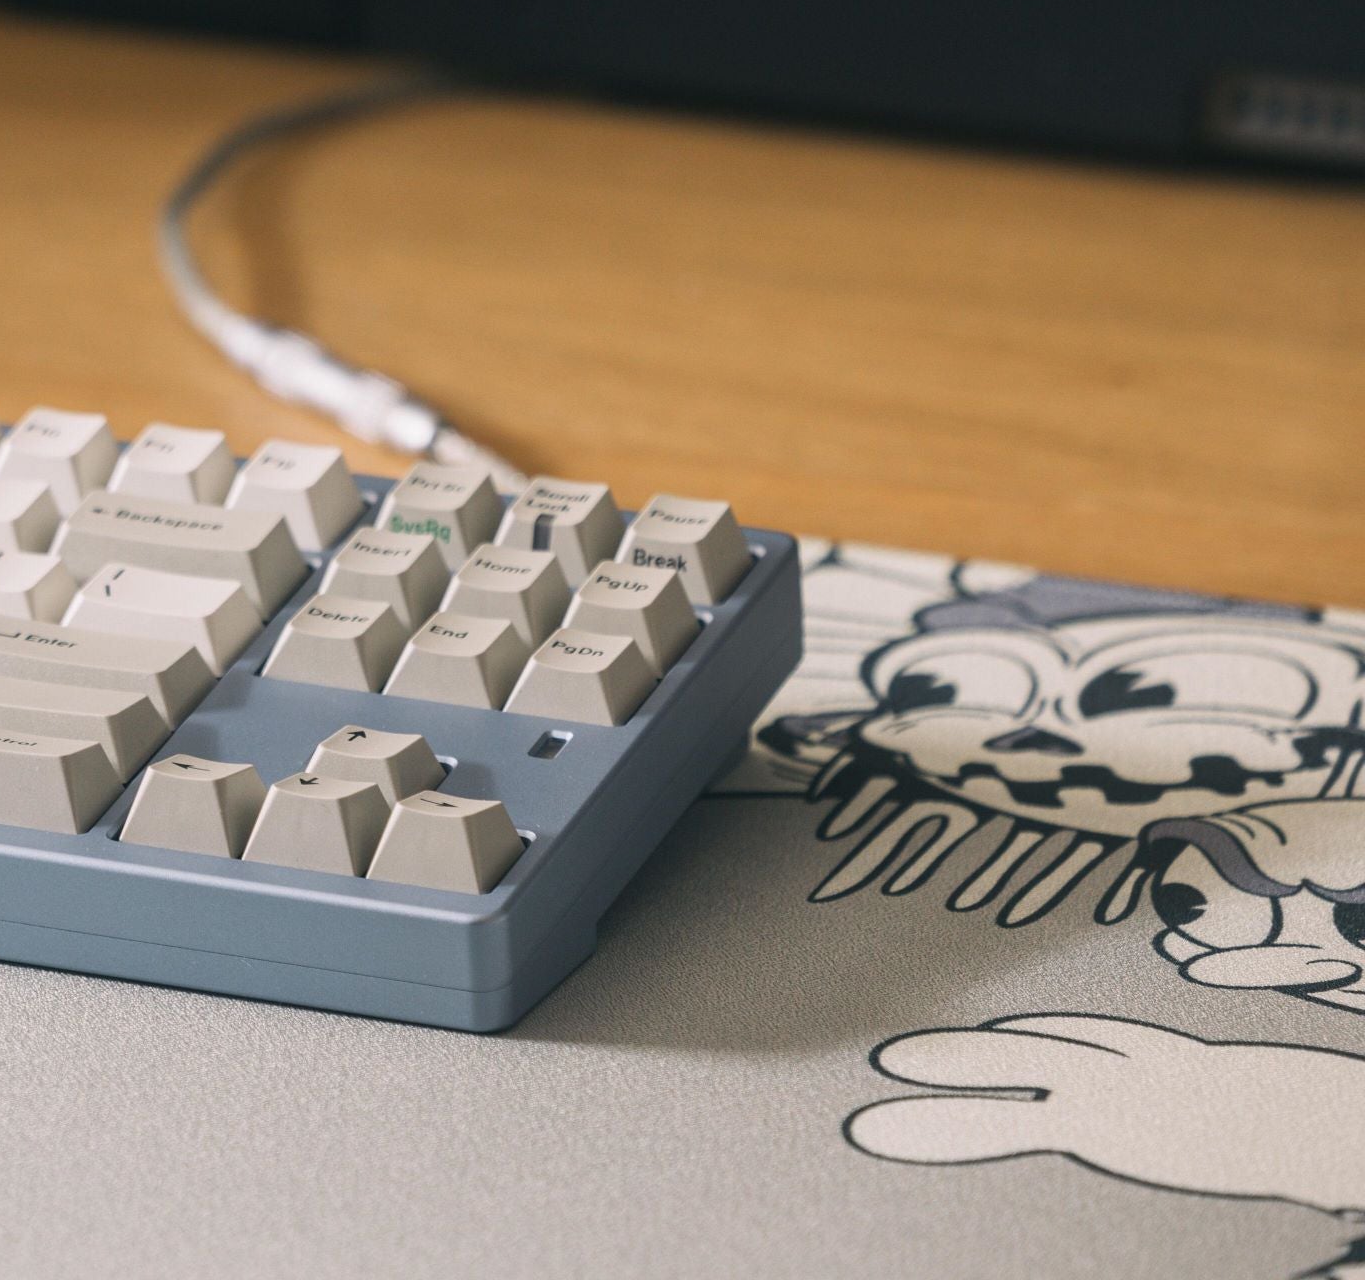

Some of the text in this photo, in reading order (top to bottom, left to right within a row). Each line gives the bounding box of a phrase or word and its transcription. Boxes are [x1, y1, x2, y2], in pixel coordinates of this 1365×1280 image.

[535, 487, 590, 503] Scroll
[526, 499, 571, 513] Lock
[115, 509, 224, 532] Backspace
[649, 508, 711, 525] Pause
[353, 541, 412, 557] Insert
[474, 558, 532, 574] Home
[632, 547, 688, 572] Break
[595, 575, 650, 593] PgUp
[308, 606, 370, 624] Delete
[429, 625, 469, 640] End
[24, 634, 78, 649] Enter
[551, 640, 605, 658] PgDn
